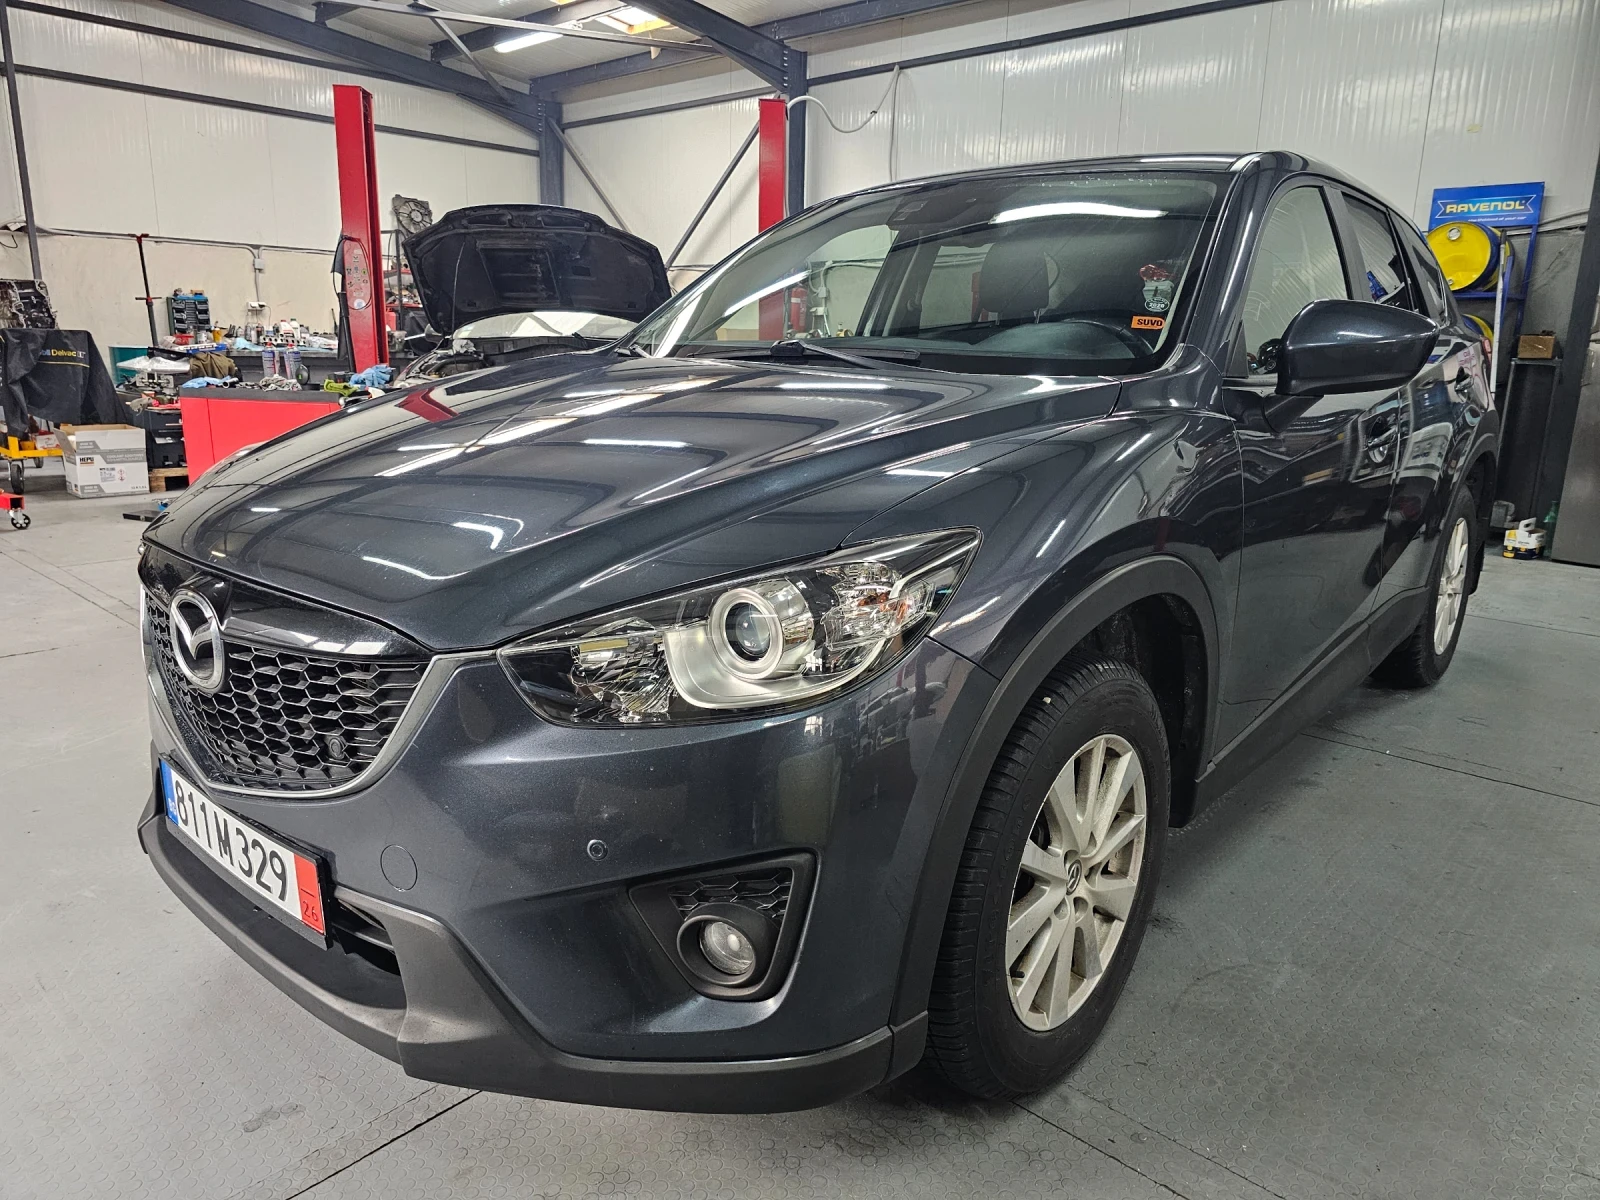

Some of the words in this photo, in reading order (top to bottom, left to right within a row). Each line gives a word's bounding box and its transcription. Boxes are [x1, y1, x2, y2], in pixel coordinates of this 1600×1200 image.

[1445, 200, 1524, 214] RAVENOL
[51, 349, 77, 357] Delvac
[175, 780, 289, 902] 811M329
[302, 900, 319, 922] 26
